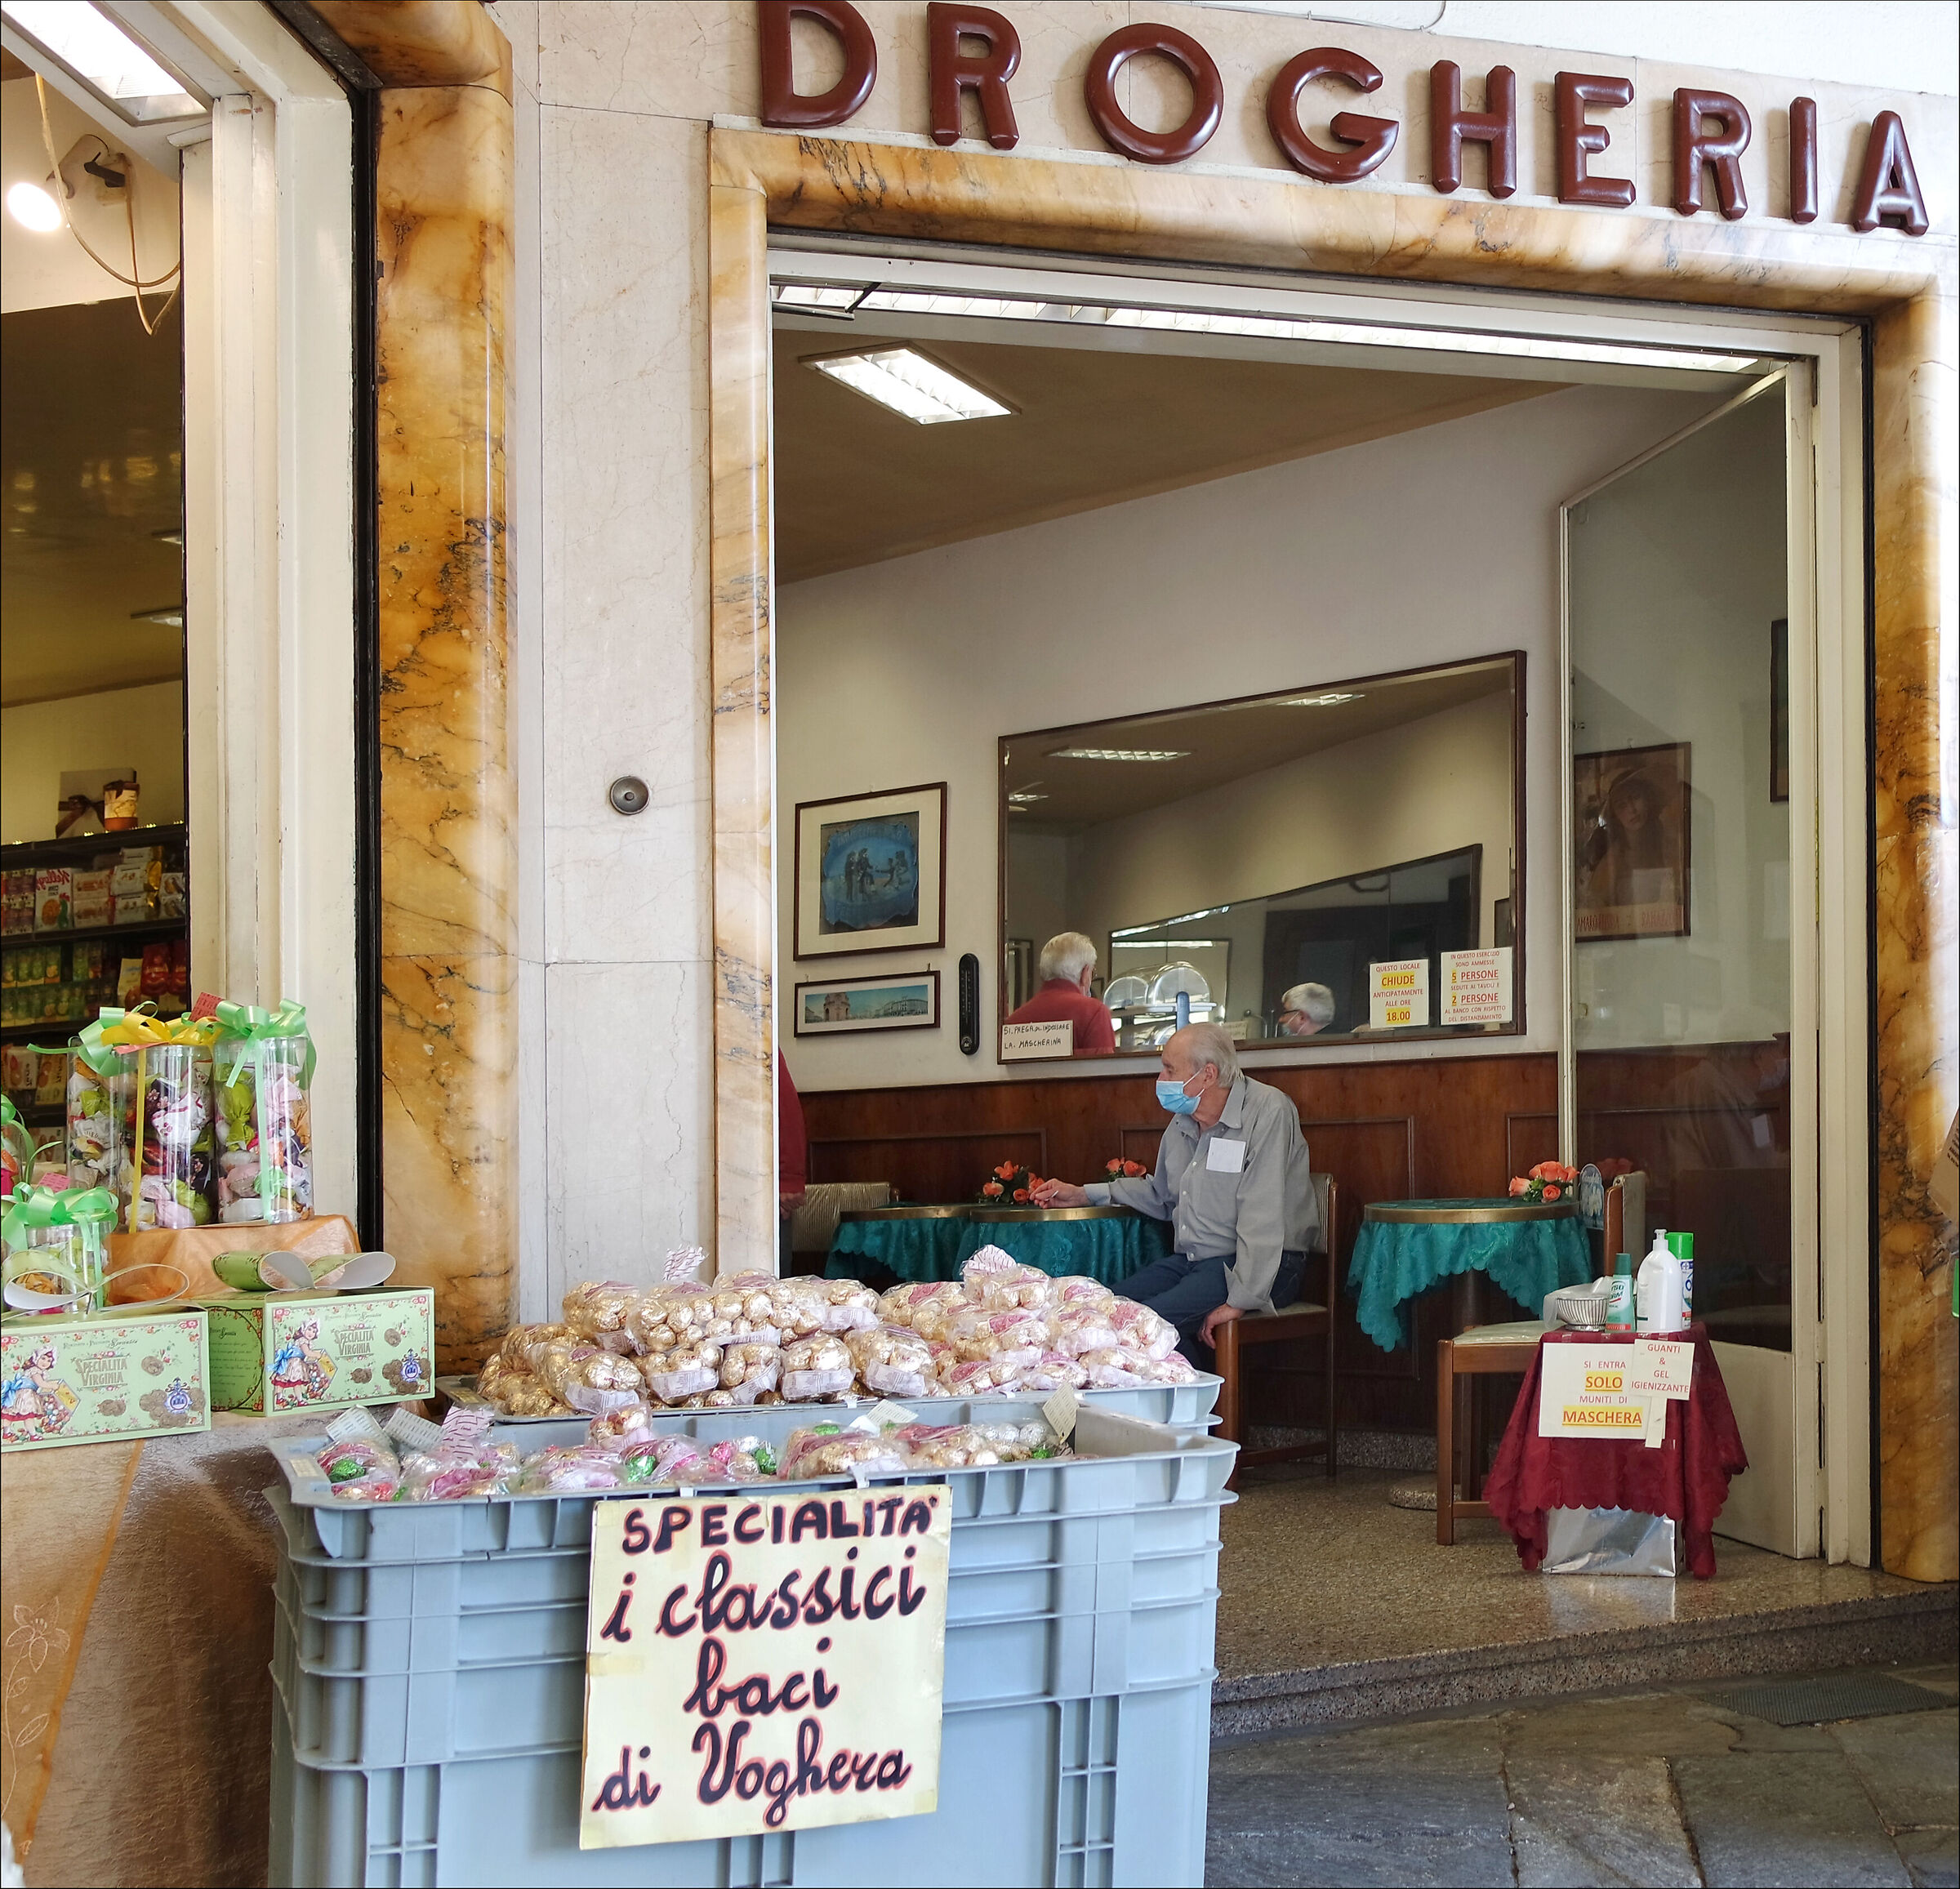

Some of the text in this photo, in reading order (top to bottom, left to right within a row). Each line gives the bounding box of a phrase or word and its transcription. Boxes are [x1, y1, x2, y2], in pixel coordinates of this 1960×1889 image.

[760, 0, 1929, 235] DROGHERIA
[1375, 965, 1398, 973] QUESTO
[1451, 969, 1499, 981] 5 PERSONE
[1381, 975, 1414, 987] CHIUDE
[1373, 988, 1423, 998] ANTICIPATAMENTE
[1451, 992, 1499, 1004] 2 PERSONE
[1386, 1011, 1410, 1022] 18.00
[1459, 1014, 1503, 1022] DISTANZIAMENTO
[1018, 1037, 1062, 1049] MASCHERINA
[338, 1341, 371, 1356] VIRGINIA
[1647, 1343, 1681, 1354] GUANTI
[1584, 1361, 1627, 1370] SI ENTRA
[1659, 1357, 1666, 1366] &
[81, 1371, 124, 1386] VIRGINIA
[1654, 1369, 1669, 1379] GEL
[1586, 1376, 1623, 1389] SOLO
[1631, 1379, 1690, 1393] IGIENIZZANTE
[1579, 1395, 1628, 1404] MUNITI DI
[1563, 1410, 1642, 1424] MASCHERA
[600, 1546, 926, 1643] i classici
[683, 1636, 840, 1718] baci
[590, 1716, 913, 1829] di Voghera
